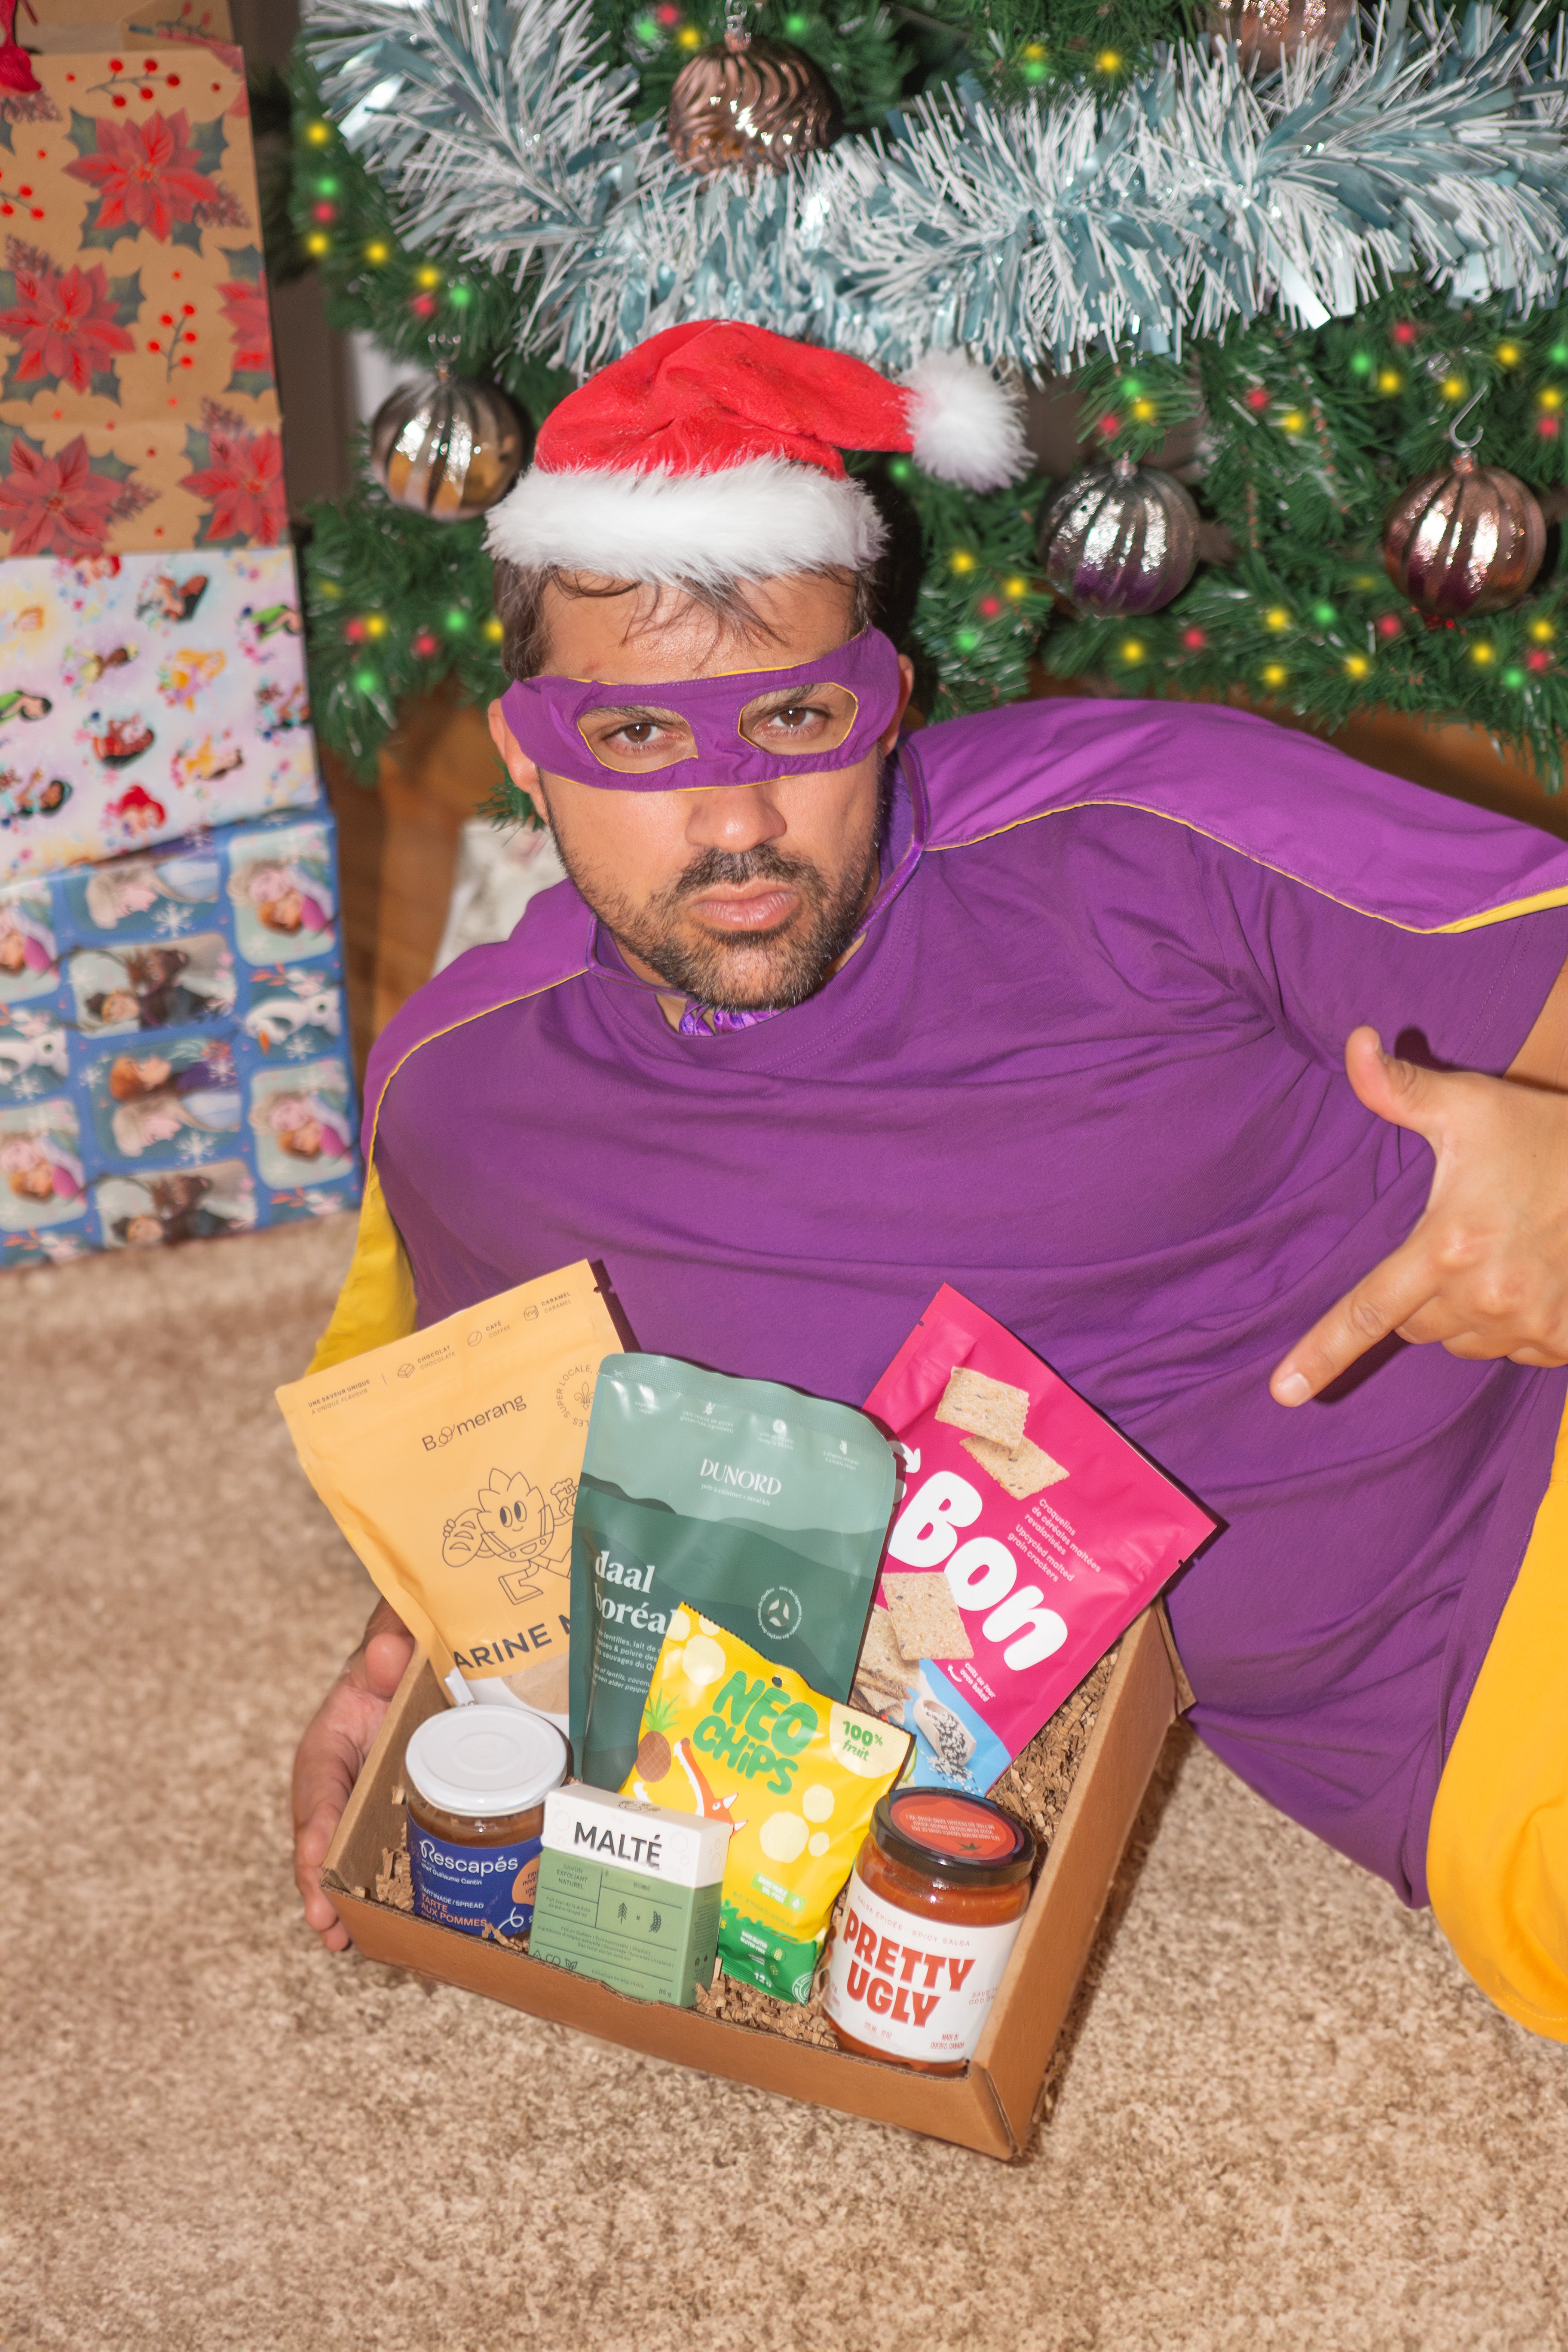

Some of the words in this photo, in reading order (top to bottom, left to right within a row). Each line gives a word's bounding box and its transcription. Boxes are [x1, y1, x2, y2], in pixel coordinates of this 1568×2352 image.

[541, 1292, 571, 1306] CARAMEL
[544, 1300, 572, 1313] CARAMEL
[486, 1320, 502, 1332] CAFÉ
[489, 1325, 511, 1338] COFFEE
[417, 1345, 451, 1363] CHOCOLAT
[420, 1351, 456, 1370] CHOCOLATE
[308, 1399, 321, 1408] UNE
[322, 1390, 346, 1403] SAVEUR
[347, 1379, 371, 1392] UNIQUE
[317, 1400, 340, 1413] UNIQUE
[341, 1389, 368, 1403] FLAVOUR
[556, 1389, 570, 1418] SUPER
[421, 1395, 527, 1452] Boomerang
[680, 1415, 706, 1427] gluten-free
[718, 1488, 742, 1499] cuisiner
[762, 1499, 771, 1507] kit
[1039, 1498, 1076, 1536] Craquelins
[1025, 1514, 1066, 1556] revalorisées
[1032, 1507, 1042, 1518] de
[1041, 1516, 1071, 1545] céréales
[1069, 1543, 1101, 1573] maltées
[1007, 1532, 1028, 1553] grain
[1026, 1550, 1059, 1582] crackers
[1015, 1523, 1049, 1558] Upcycled
[1046, 1555, 1075, 1582] malted
[595, 1550, 655, 1594] daal
[888, 1470, 1068, 1671] Bon
[761, 1587, 775, 1601] Québec
[453, 1623, 552, 1669] ARINE
[604, 1632, 631, 1647] lentilles,
[634, 1641, 645, 1650] lait
[647, 1644, 656, 1652] de
[603, 1652, 634, 1666] sauvages
[635, 1660, 644, 1669] du
[620, 1648, 643, 1659] poivre
[645, 1654, 658, 1663] des
[606, 1670, 626, 1681] lentils,
[965, 1661, 978, 1678] cuits
[976, 1676, 985, 1686] au
[608, 1680, 625, 1689] alder
[625, 1684, 649, 1695] pepper
[960, 1669, 974, 1685] oven
[971, 1681, 990, 1703] baked
[712, 1670, 818, 1756] NEO
[842, 1721, 883, 1746] 100%
[843, 1740, 869, 1761] fruit
[574, 1821, 662, 1870] MALTÉ
[419, 1839, 518, 1877] Rescapés
[432, 1869, 460, 1883] Guillaume
[461, 1877, 482, 1886] Cantin
[557, 1869, 588, 1883] EXFOLIANT
[563, 1864, 583, 1874] SAVON
[558, 1878, 584, 1890] NATUREL
[757, 1875, 773, 1888] SANS
[421, 1892, 448, 1913] TARTE
[733, 1891, 743, 1900] NO
[421, 1902, 438, 1917] AUX
[440, 1911, 487, 1927] POMMES
[858, 1895, 873, 1914] SALSA
[875, 1911, 903, 1931] ÉPICÉE
[912, 1930, 938, 1942] SPICY
[942, 1939, 970, 1947] SALSA
[740, 1937, 765, 1955] GLUTEN-FREE
[741, 1930, 753, 1941] SANS
[752, 1936, 768, 1949] GLUTEN
[842, 1906, 977, 1992] PRETTY
[846, 1959, 942, 2029] UGLY
[972, 1990, 990, 1998] SAVE
[948, 2042, 965, 2050] CANADA
